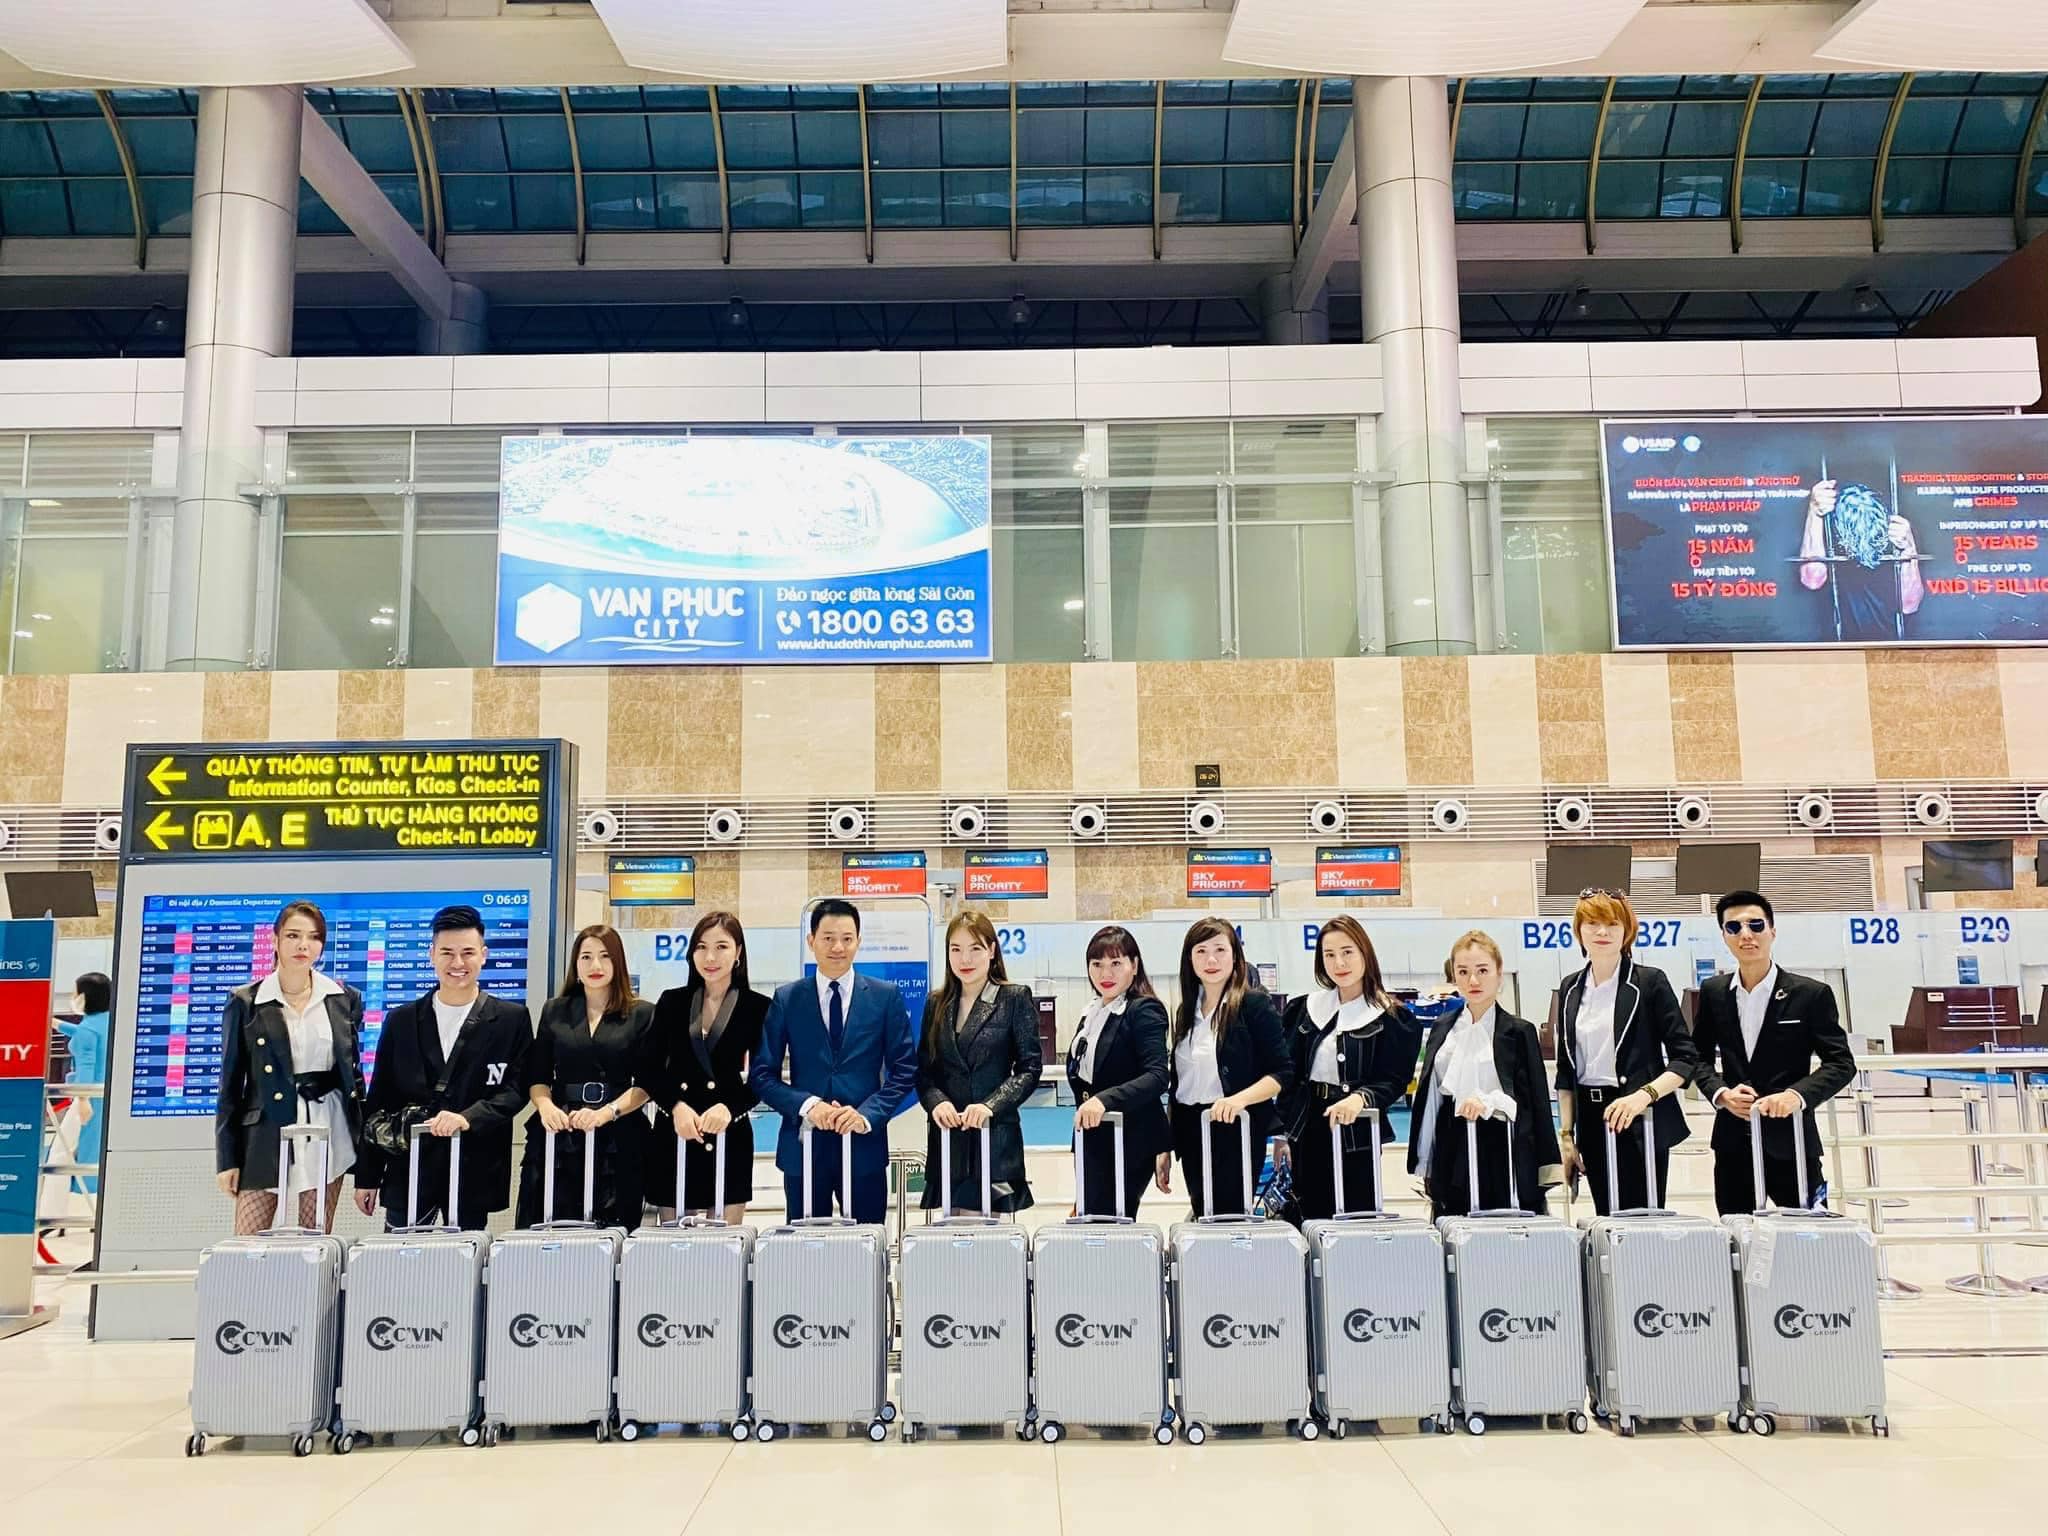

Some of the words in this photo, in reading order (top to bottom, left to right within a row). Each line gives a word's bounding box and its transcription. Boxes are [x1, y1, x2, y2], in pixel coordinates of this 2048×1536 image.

[1946, 472, 2016, 482] TRANSPORTING
[2017, 473, 2025, 481] &
[1955, 485, 1999, 494] WILDLIFE
[1953, 498, 1974, 508] ARE
[1975, 496, 2018, 507] CRIMES
[1939, 520, 2009, 530] IMPRISONMENT
[2010, 520, 2023, 529] OF
[2025, 520, 2037, 529] UP
[1711, 535, 1754, 554] NĂM
[1976, 535, 2039, 550] YEARS
[1967, 564, 1988, 573] FINE
[2020, 563, 2032, 572] TO
[1671, 582, 1690, 598] 15
[1926, 578, 1969, 594] VND
[1972, 578, 1992, 593] 15
[588, 586, 651, 617] VAN
[662, 586, 745, 617] PHUC
[811, 588, 847, 604] ngọc
[884, 586, 916, 603] lòng
[944, 586, 975, 601] Gòn
[633, 618, 699, 638] CITY
[807, 609, 883, 635] 1800
[889, 608, 929, 635] 63
[936, 608, 975, 634] 63
[777, 637, 973, 651] www.khudothivanphuc.com.vn
[206, 755, 263, 777] QUÀY
[266, 754, 336, 776] THÔNG
[338, 756, 374, 777] TIN,
[379, 755, 409, 776] TỰ
[411, 752, 453, 774] LÀM
[500, 754, 540, 775] TỤC
[228, 778, 332, 797] Information
[335, 777, 411, 797] Counter,
[415, 776, 456, 795] Kios
[460, 775, 540, 794] Check-in
[364, 806, 405, 828] TỤC
[407, 803, 465, 824] HÀNG
[468, 801, 539, 823] KHÔNG
[234, 814, 271, 848] A,
[281, 813, 307, 846] E
[396, 827, 477, 846] Check-in
[480, 826, 537, 848] Lobby
[848, 876, 871, 885] SKY
[970, 874, 993, 883] SKY
[1192, 871, 1216, 881] SKY
[1320, 871, 1344, 880] SKY
[1320, 879, 1374, 888] PRIORITY
[848, 884, 899, 893] PRIORITY
[970, 881, 1022, 890] PRIORITY
[1192, 880, 1245, 889] PRIORITY
[496, 895, 528, 905] 06:03
[1523, 922, 1572, 949] B26
[1635, 920, 1681, 948] B27
[1850, 917, 1900, 944] B28
[1960, 916, 2010, 943] B29
[655, 934, 688, 961] B2
[997, 928, 1026, 955] 23
[912, 979, 926, 988] TAY
[486, 1062, 508, 1086] N
